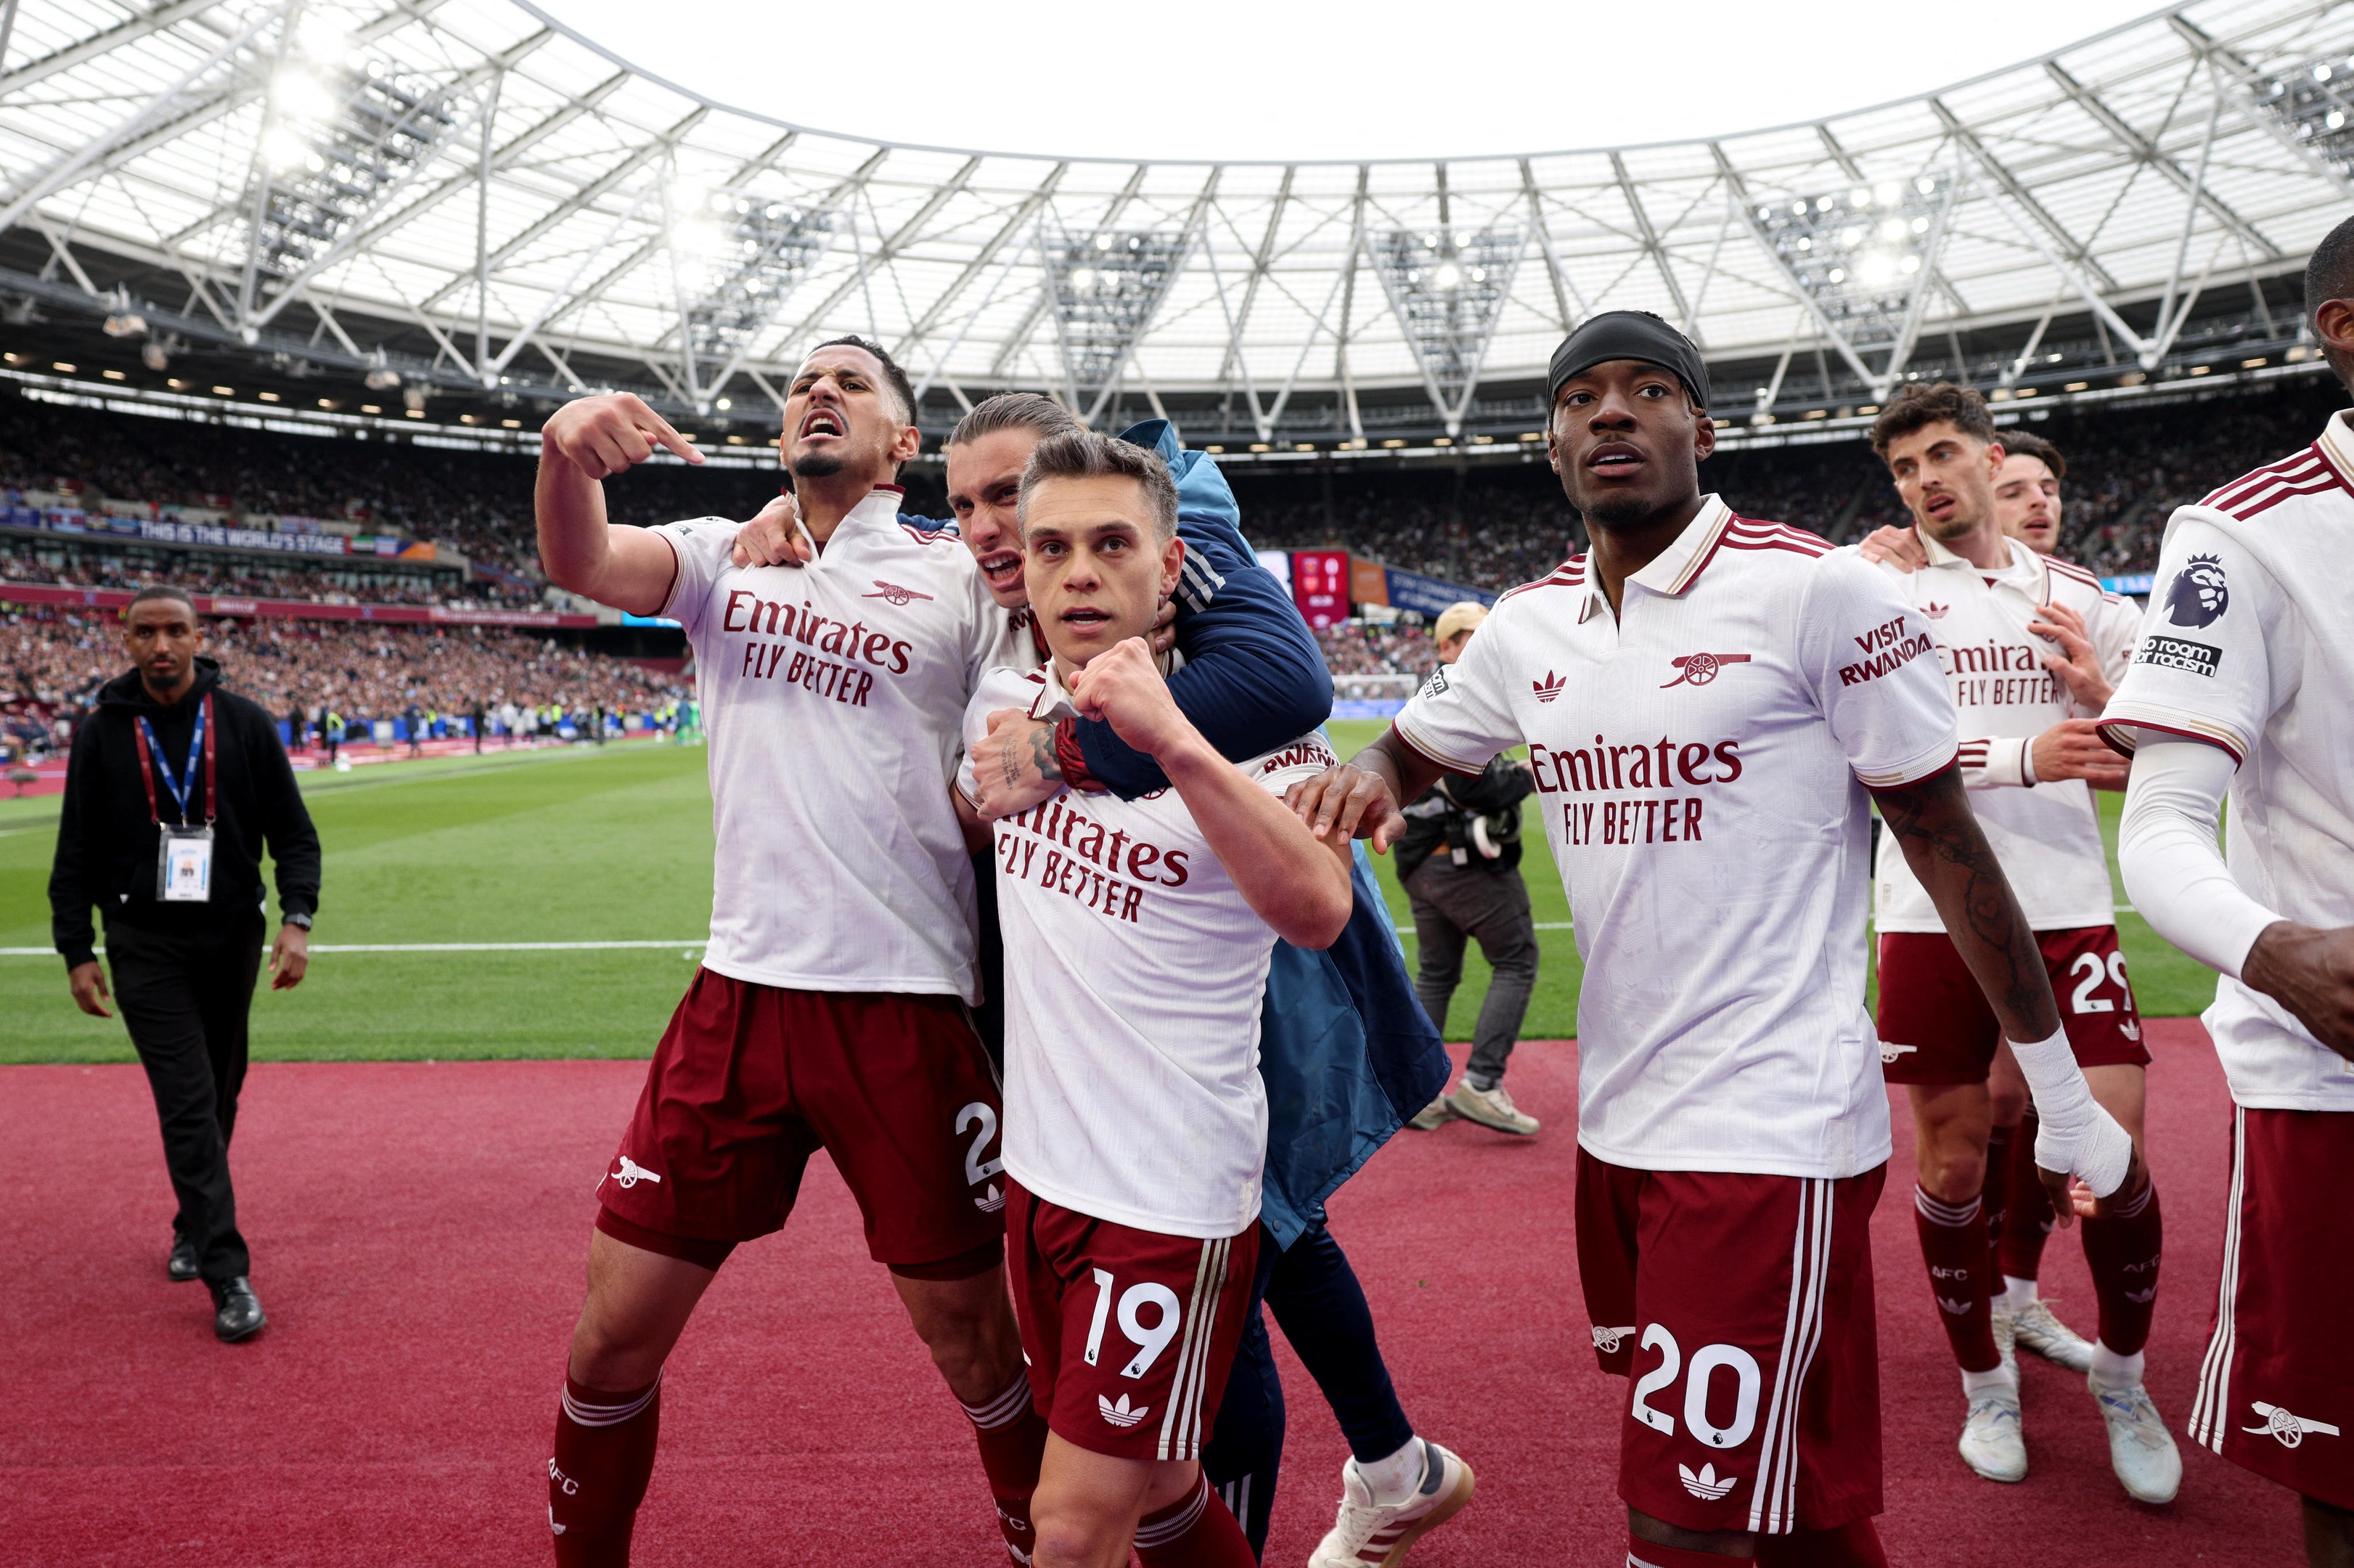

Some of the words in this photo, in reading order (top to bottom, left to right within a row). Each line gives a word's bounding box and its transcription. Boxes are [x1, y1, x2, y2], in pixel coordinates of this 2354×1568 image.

[140, 520, 175, 541] THIS
[176, 524, 192, 542] IS
[195, 526, 225, 544] THE
[226, 530, 295, 551] WORLD'S
[295, 534, 345, 555] STAGE
[723, 589, 912, 674] Emirates
[1854, 616, 1905, 654] VISIT
[2158, 640, 2212, 662] room
[742, 642, 785, 679] FLY
[787, 651, 873, 707] BETTER
[1839, 632, 1932, 687] RWANDA
[1935, 639, 2053, 677] mira
[2152, 652, 2216, 677] racism
[1958, 679, 1987, 707] FLY
[1529, 734, 1742, 793] Emirates
[994, 794, 1189, 887] irates
[1564, 803, 1594, 845] FLY
[1603, 798, 1702, 845] BETTER
[997, 833, 1039, 879] FLY
[1040, 850, 1143, 923] BETTER
[2069, 950, 2132, 1015] 29
[1932, 1265, 1968, 1281] AFC
[2124, 1254, 2160, 1273] AFC
[1083, 1267, 1180, 1380] 19
[1631, 1322, 1762, 1450] 20
[993, 1498, 1027, 1531] FC
